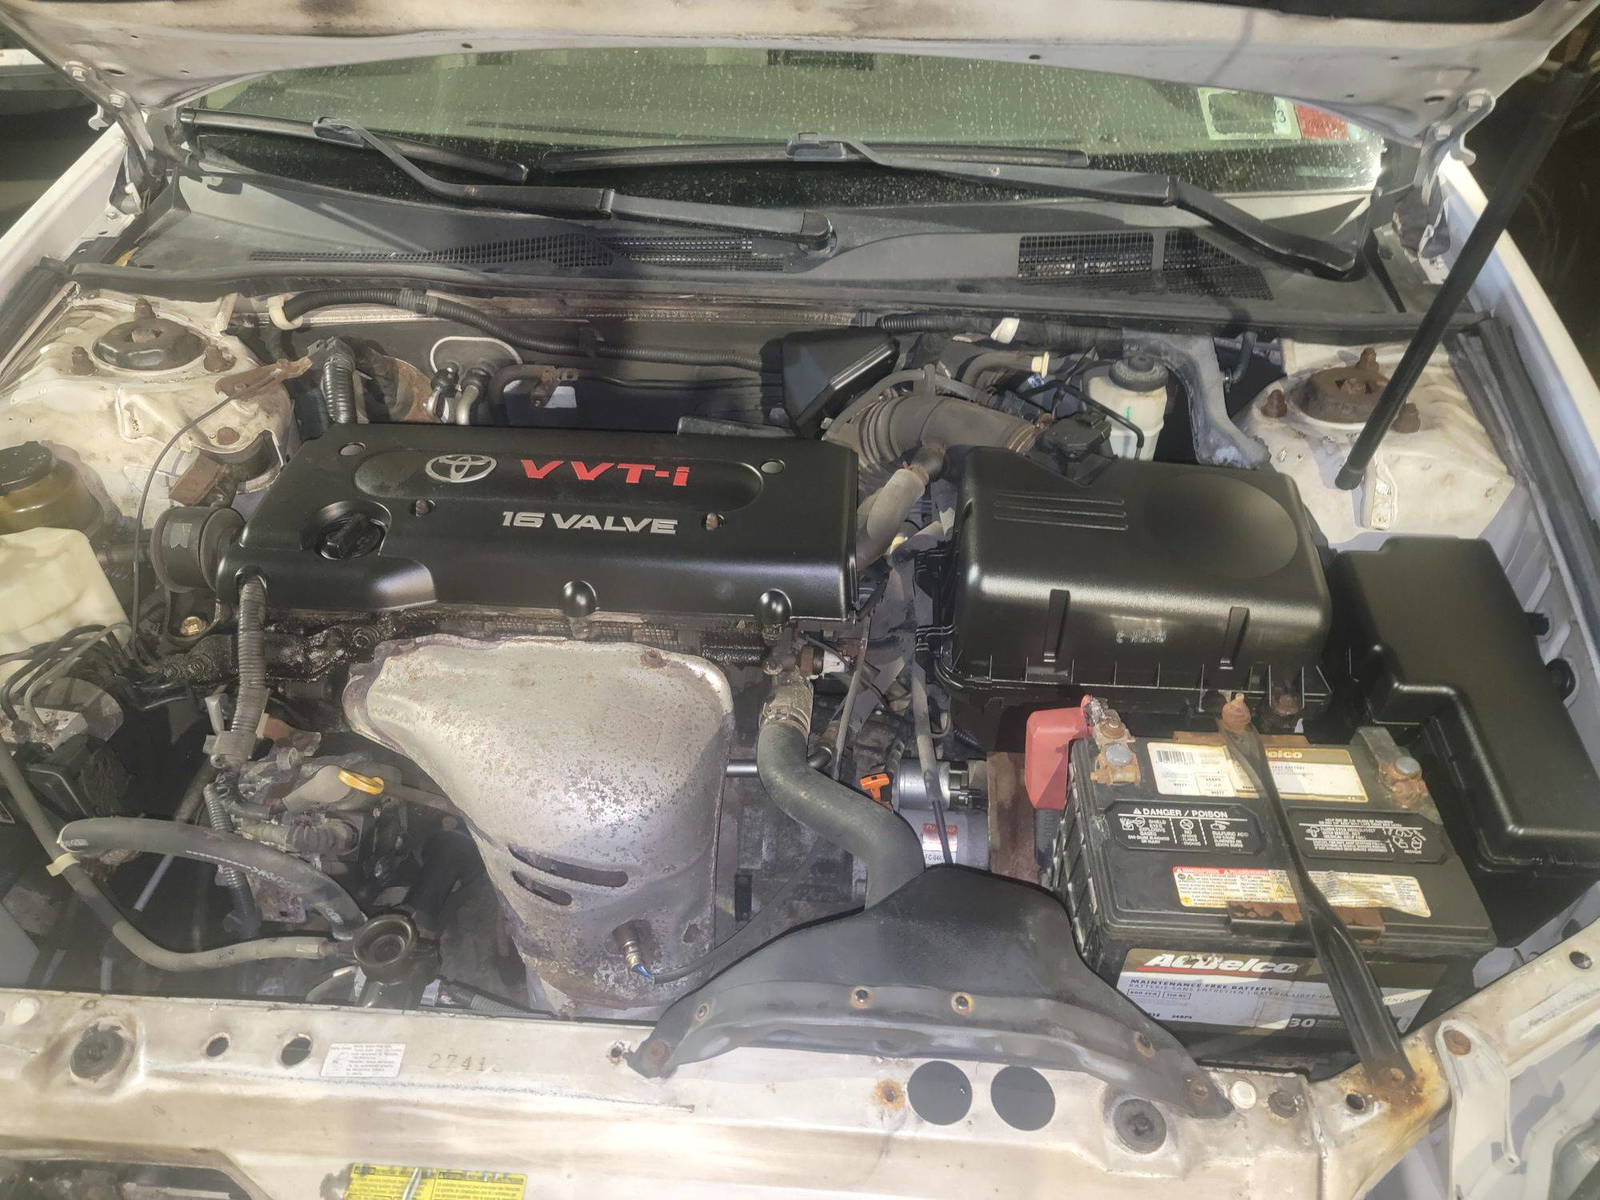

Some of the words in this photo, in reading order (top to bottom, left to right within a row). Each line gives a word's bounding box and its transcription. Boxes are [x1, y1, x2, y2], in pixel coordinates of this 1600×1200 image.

[521, 459, 690, 487] VVT-i
[502, 511, 545, 528] 16
[552, 513, 678, 535] VALVE
[1264, 749, 1303, 759] elco
[1142, 807, 1182, 817] DANGER
[1191, 809, 1228, 818] POISON
[1144, 953, 1299, 974] ACDelco
[1130, 979, 1202, 988] MAINTENANCE
